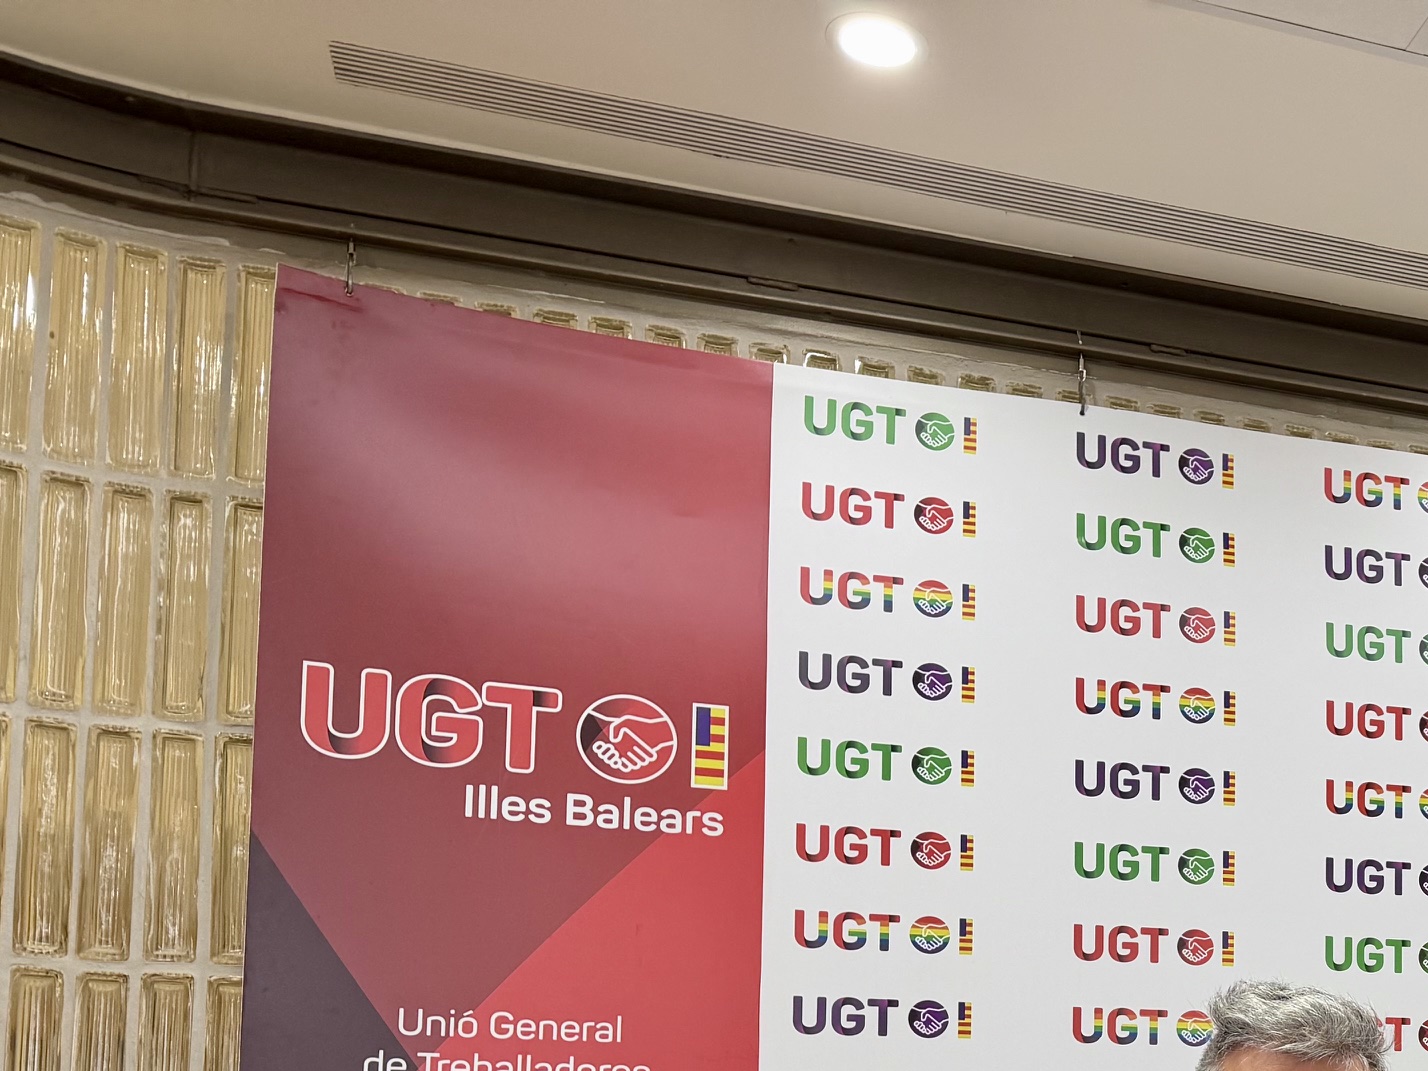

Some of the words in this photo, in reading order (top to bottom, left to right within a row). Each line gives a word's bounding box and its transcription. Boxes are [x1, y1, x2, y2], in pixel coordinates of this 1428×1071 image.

[804, 395, 906, 445] UGT
[1076, 431, 1170, 478] UGT
[802, 482, 905, 529] UGT
[1324, 467, 1410, 510] UGT
[1076, 513, 1171, 558] UGT
[1325, 545, 1411, 586] UGT
[800, 566, 904, 613] UGT
[1076, 595, 1171, 639] UGT
[1326, 622, 1411, 663] UGT
[799, 651, 903, 696] UGT
[300, 660, 563, 774] UGT
[1076, 677, 1171, 720] UGT
[1326, 700, 1412, 741] UGT
[797, 736, 902, 781] UGT
[1075, 759, 1170, 801] UGT
[1326, 779, 1412, 819] UGT
[464, 784, 552, 825] Illes
[565, 792, 726, 837] Balears
[796, 823, 901, 866] UGT
[1074, 841, 1170, 882] UGT
[1326, 857, 1411, 896] UGT
[794, 909, 900, 951] UGT
[1073, 924, 1169, 963] UGT
[1325, 936, 1411, 974] UGT
[398, 1007, 479, 1040] Unió
[489, 1011, 623, 1043] General
[793, 995, 899, 1037] UGT
[1072, 1007, 1168, 1045] UGT
